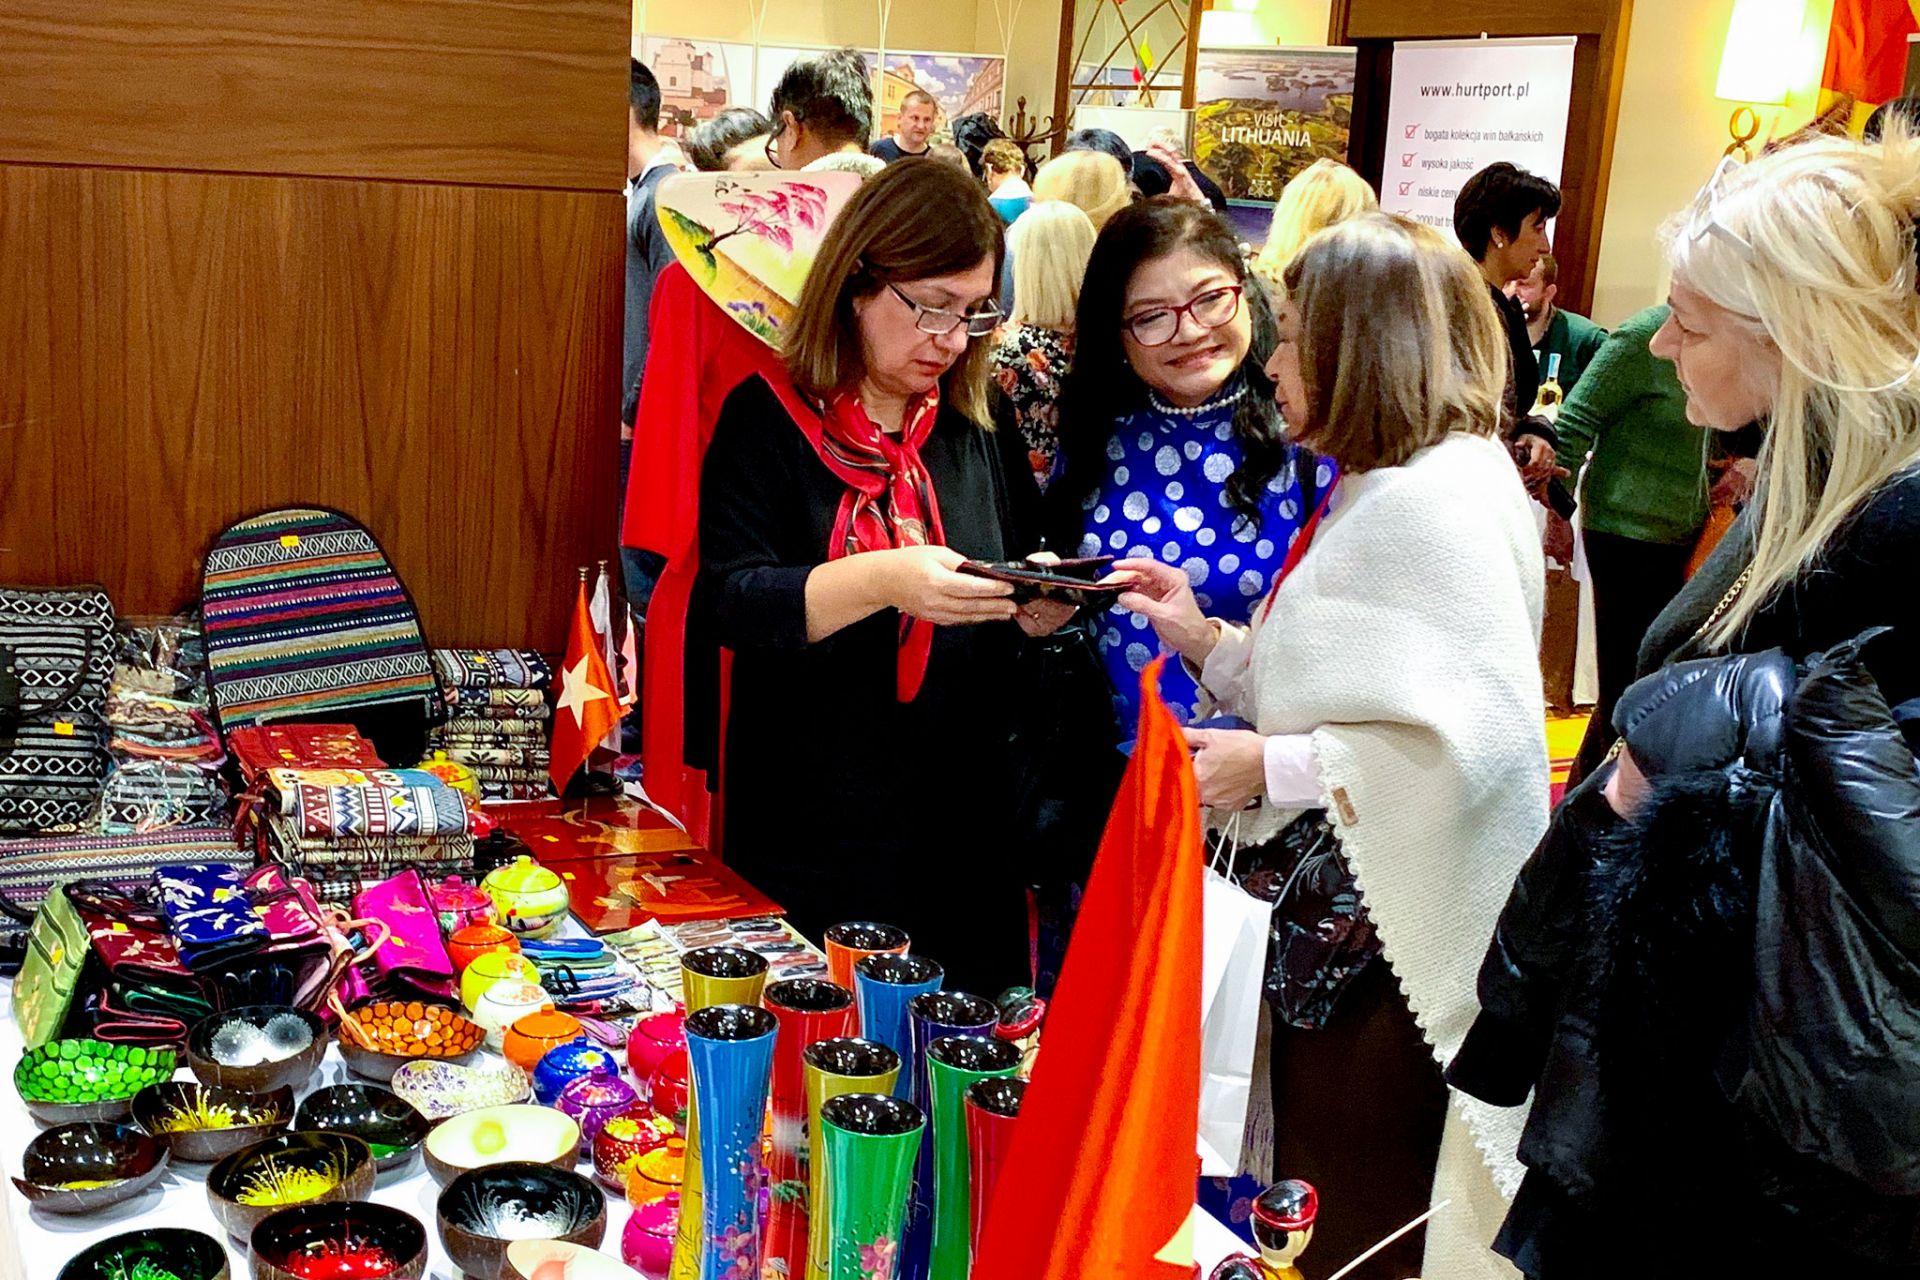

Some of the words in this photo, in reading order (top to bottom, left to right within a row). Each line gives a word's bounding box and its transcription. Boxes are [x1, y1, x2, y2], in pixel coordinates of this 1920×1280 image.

[1420, 82, 1529, 100] www.hurtport.pl
[1222, 127, 1311, 147] LITHUANIA
[1424, 128, 1449, 142] bogata
[1450, 129, 1481, 143] kolekcja
[1421, 157, 1448, 171] wysoka
[1417, 186, 1440, 198] niskie
[1440, 188, 1458, 201] ceny
